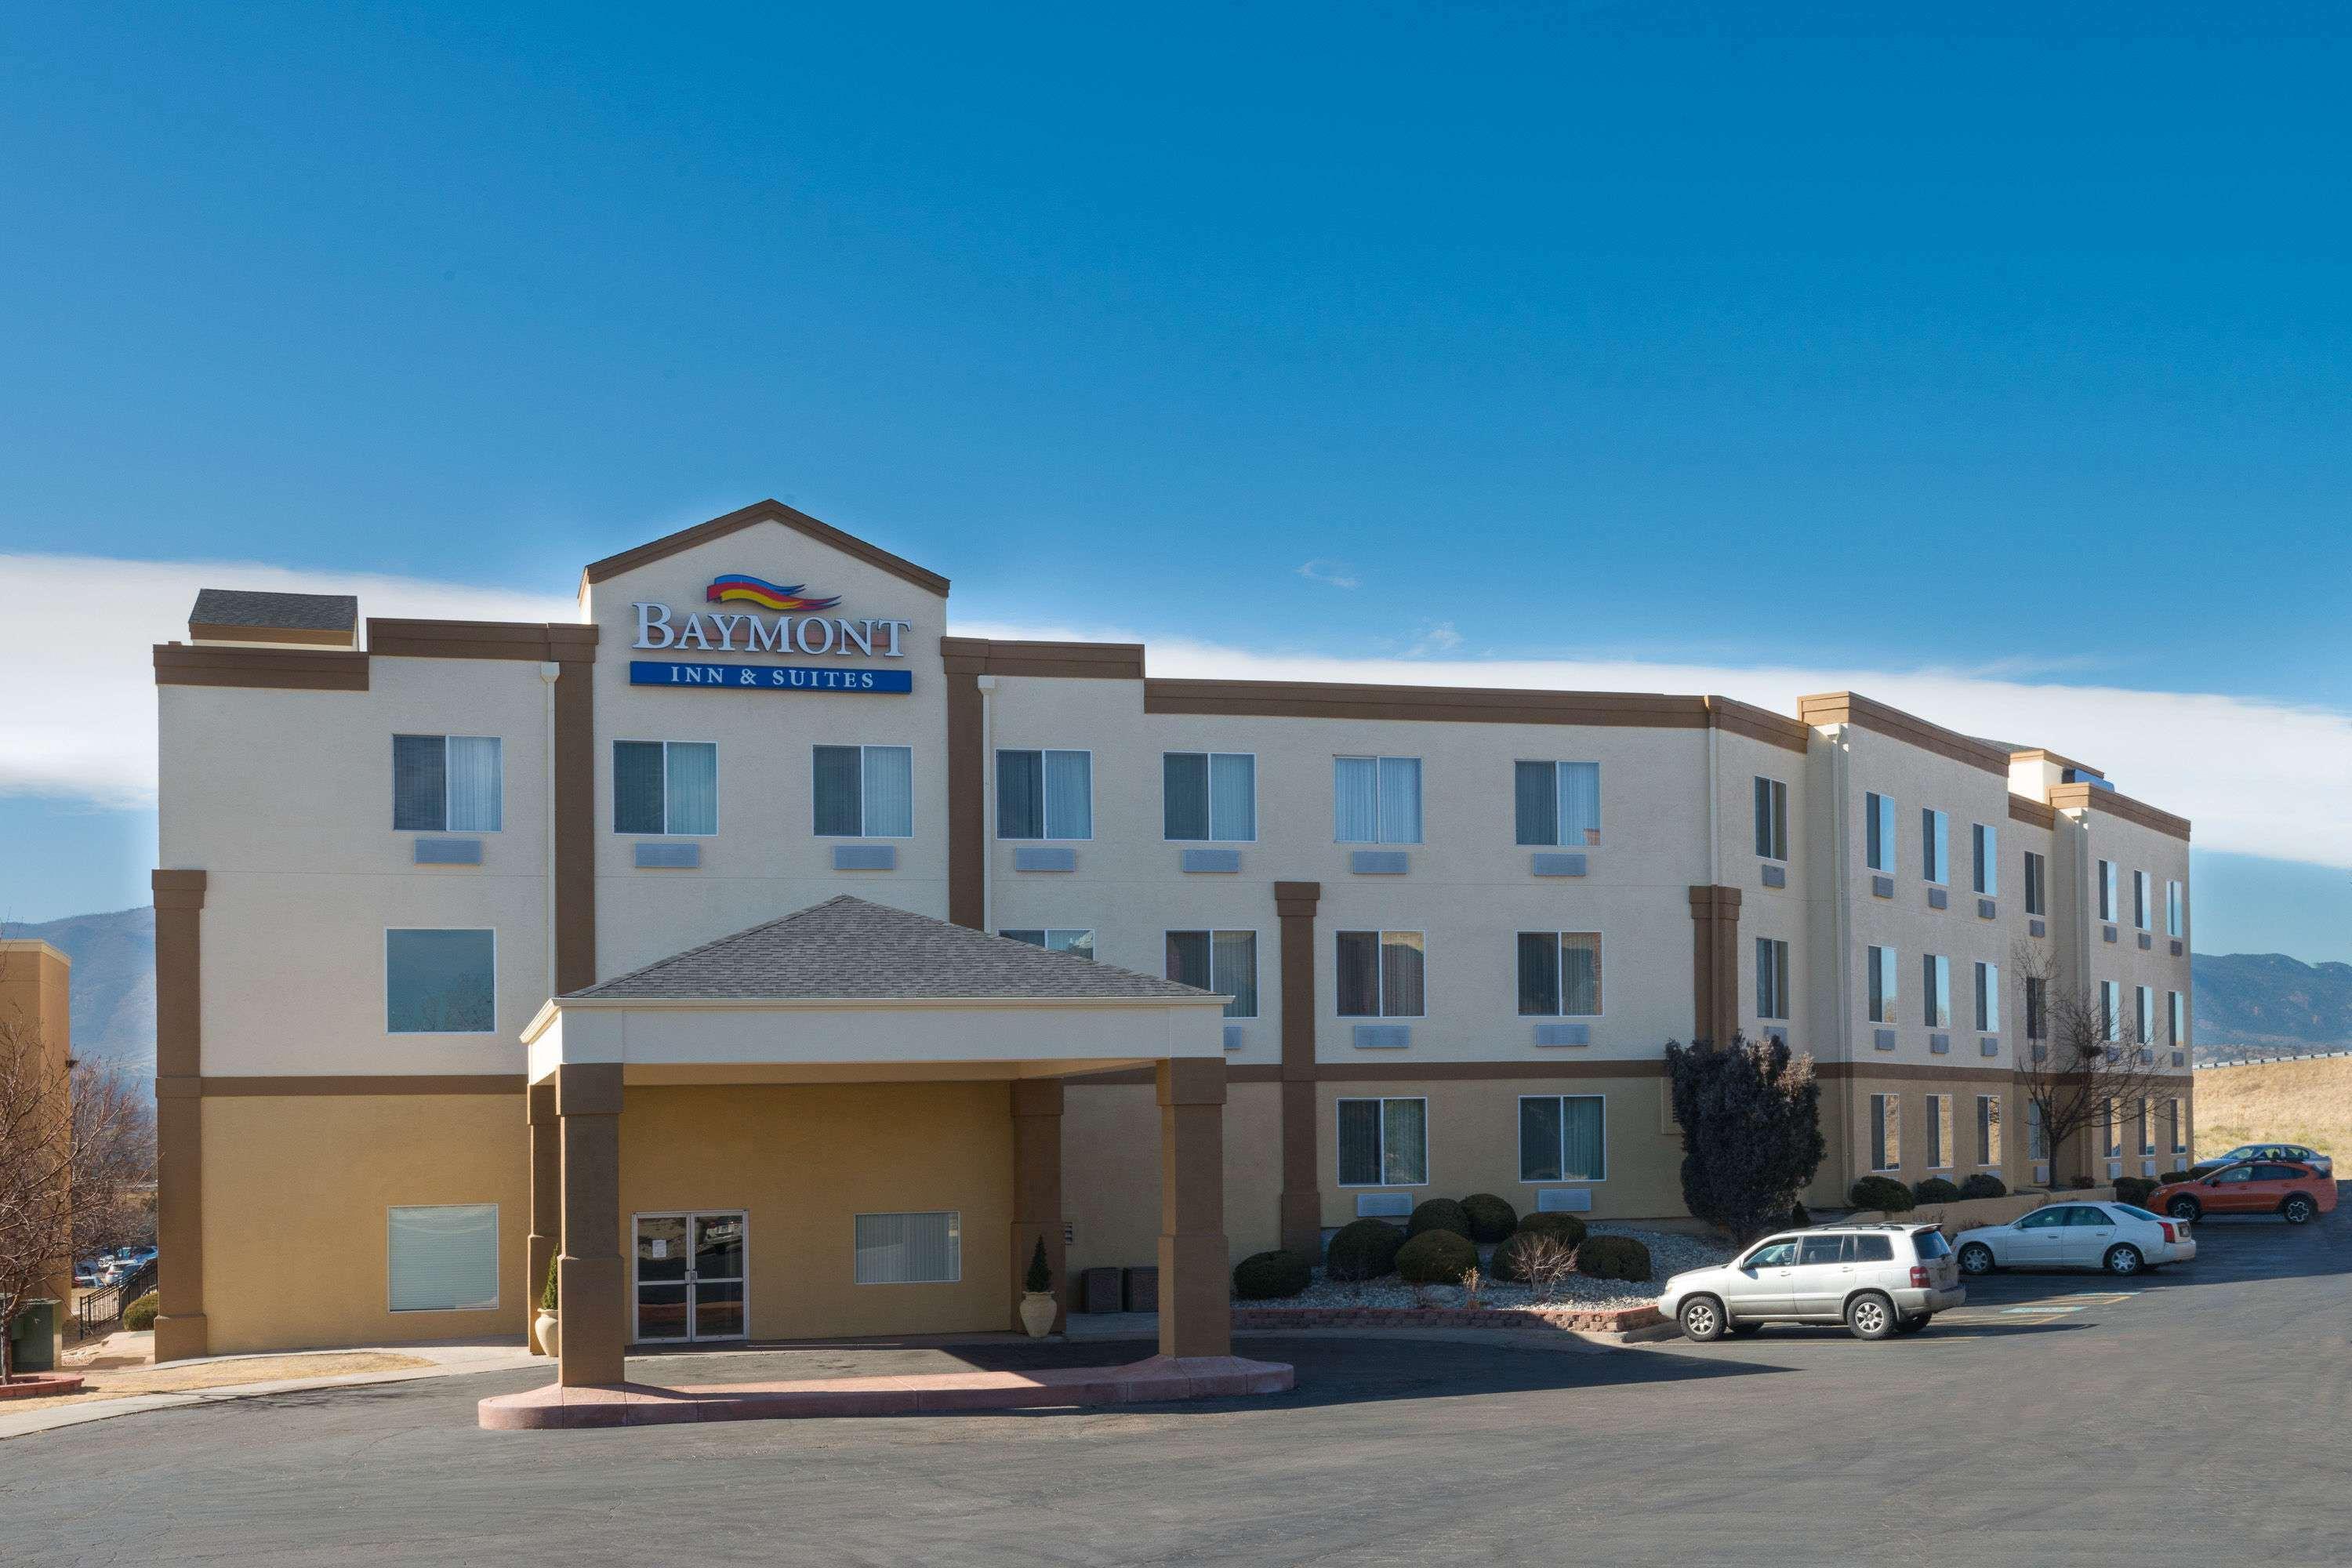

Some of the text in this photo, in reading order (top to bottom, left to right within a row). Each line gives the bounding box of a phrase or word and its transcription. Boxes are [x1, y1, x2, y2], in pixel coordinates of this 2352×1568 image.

[633, 601, 910, 657] BAYMONT
[670, 666, 874, 688] INN & SUITES
